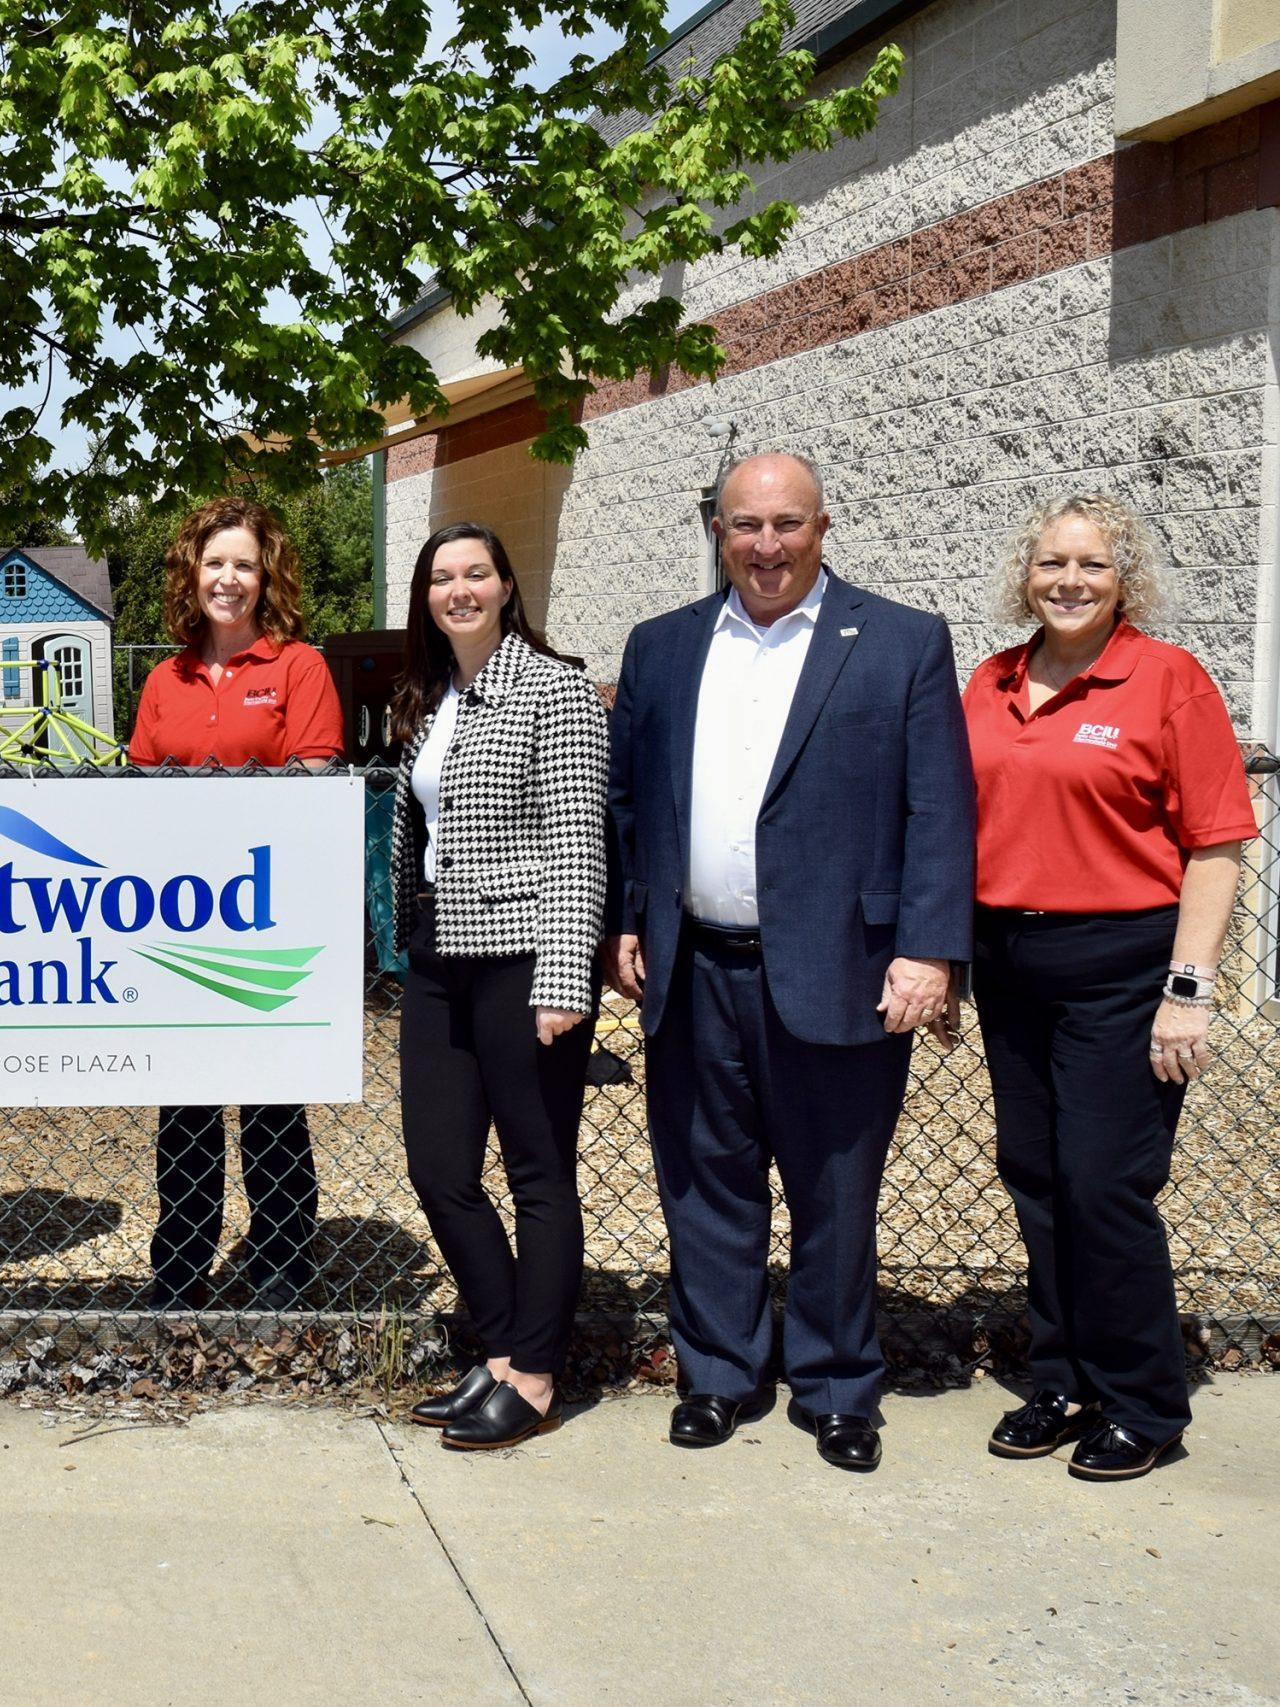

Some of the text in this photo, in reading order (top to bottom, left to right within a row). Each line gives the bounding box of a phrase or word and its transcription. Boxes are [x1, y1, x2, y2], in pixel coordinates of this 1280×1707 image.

[1078, 723, 1120, 739] BCIU
[61, 1054, 136, 1073] PLAZA
[144, 1054, 152, 1072] 1
